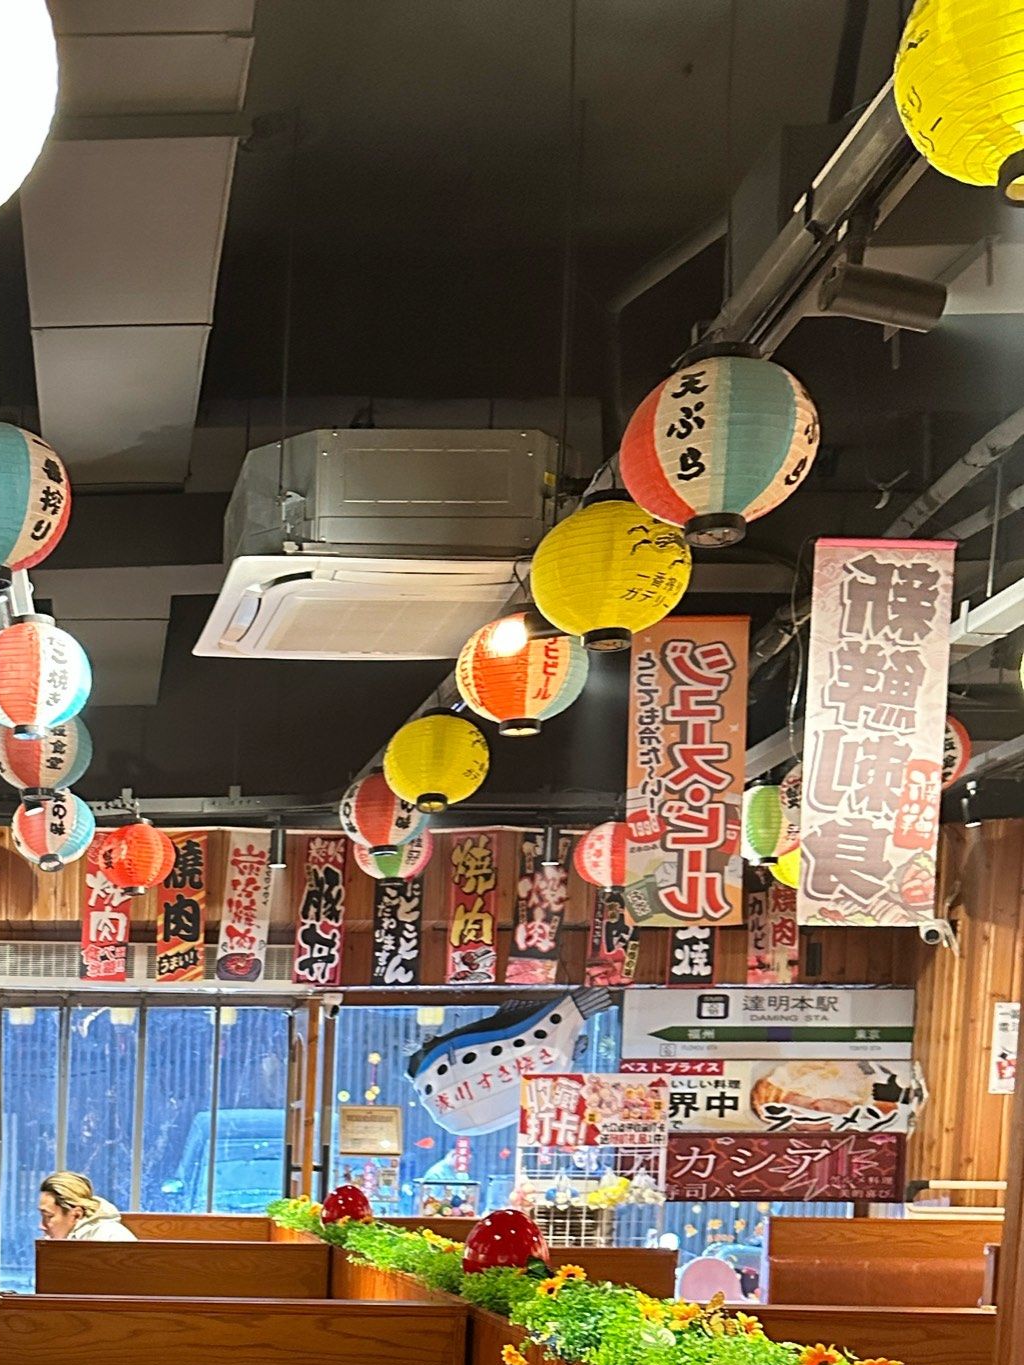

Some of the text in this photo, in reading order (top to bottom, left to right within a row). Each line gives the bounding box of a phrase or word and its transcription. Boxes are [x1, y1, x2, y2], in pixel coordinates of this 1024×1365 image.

[742, 995, 838, 1013] 達明本駅
[749, 1014, 829, 1022] DAMING STA
